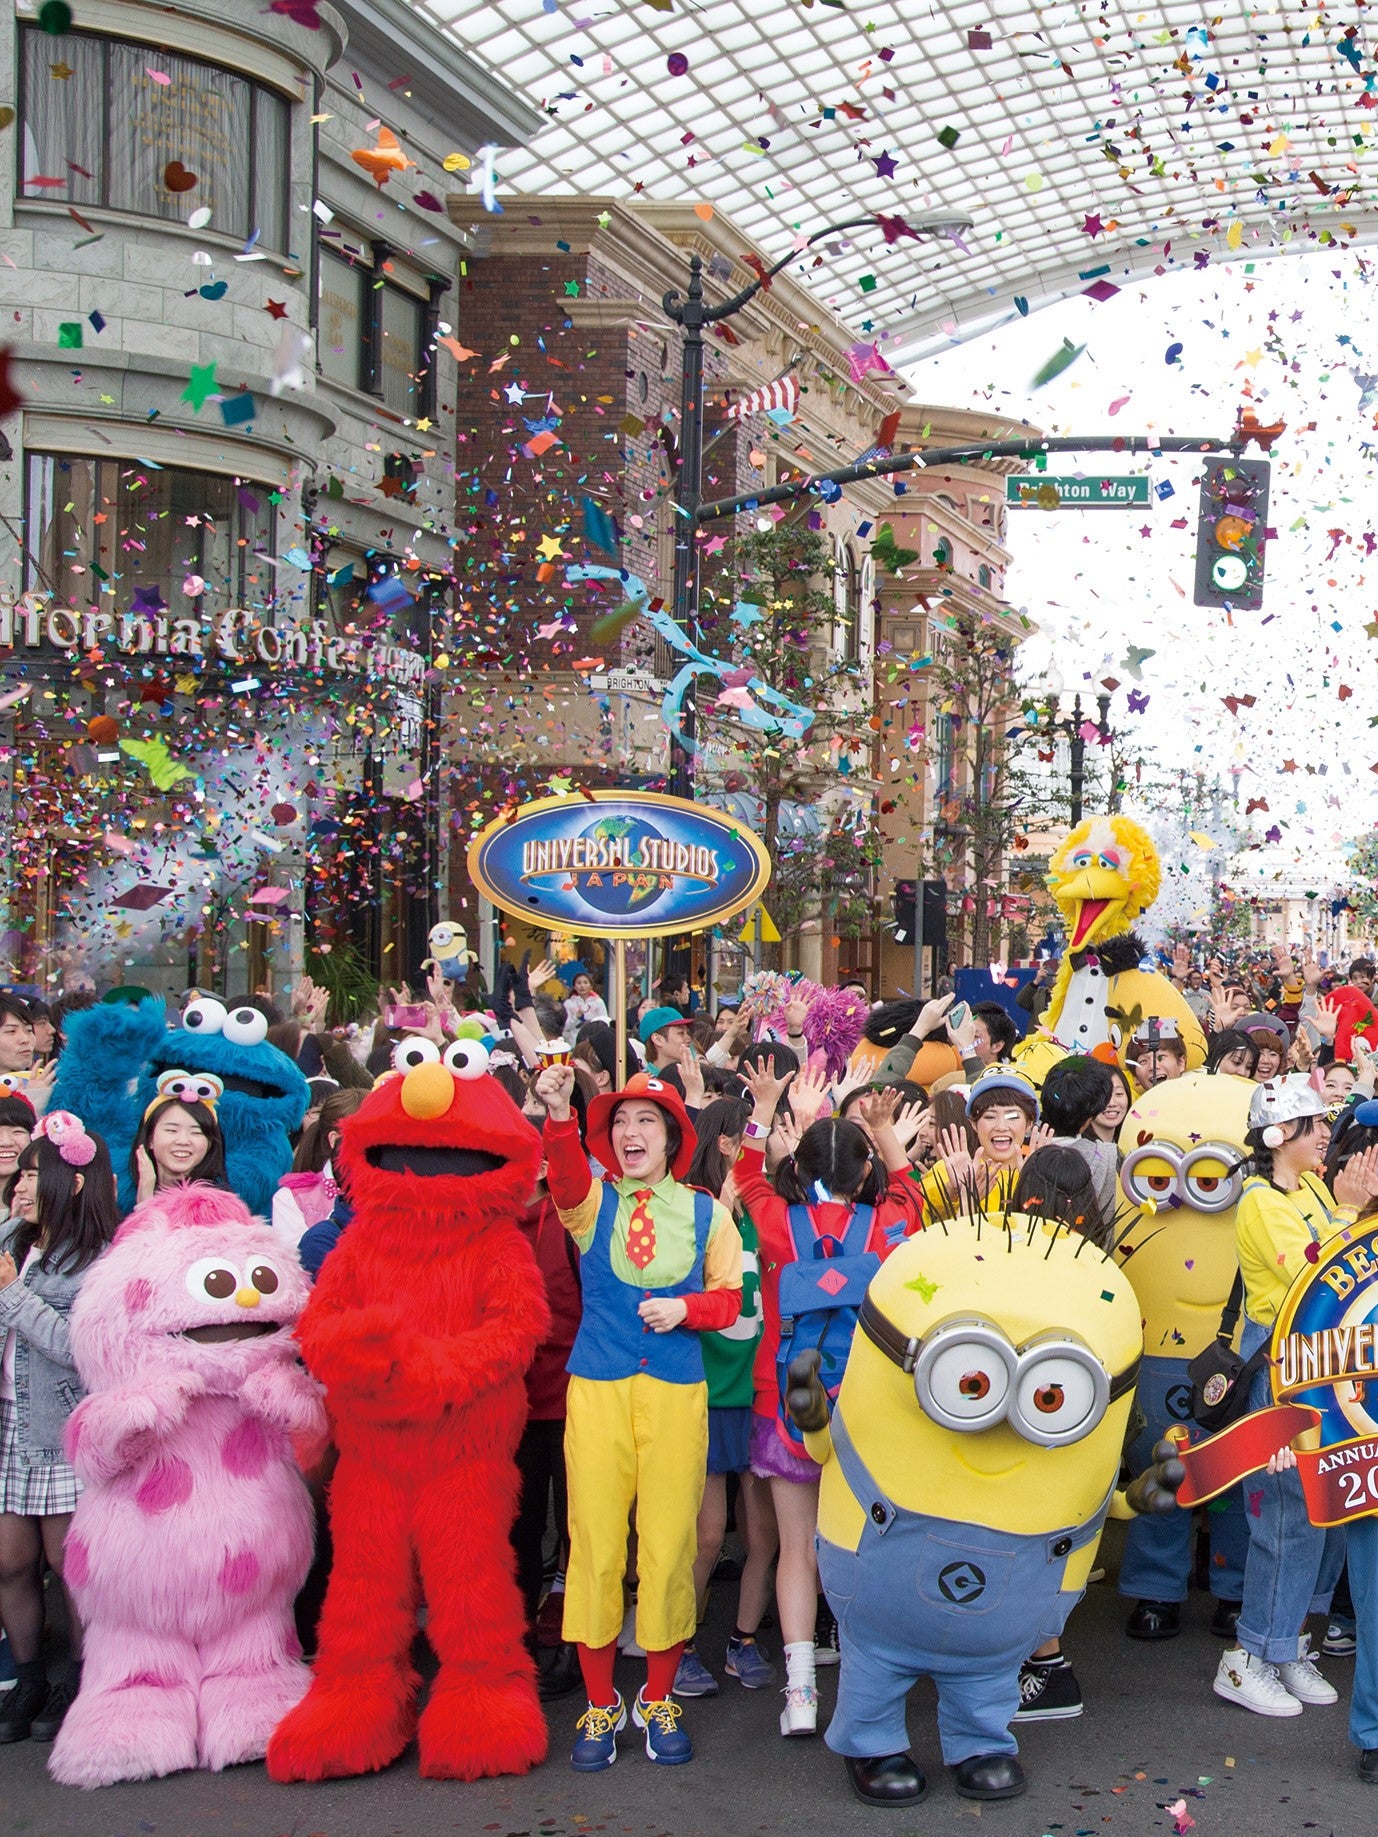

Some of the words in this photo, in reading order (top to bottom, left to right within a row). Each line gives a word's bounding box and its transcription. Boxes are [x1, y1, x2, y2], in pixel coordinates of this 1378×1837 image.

[1100, 482, 1136, 500] Way
[607, 678, 650, 689] BRIGHTON
[523, 836, 637, 874] UNIVERSAL
[639, 836, 719, 879] STUDIOS
[565, 872, 674, 890] JAPAN
